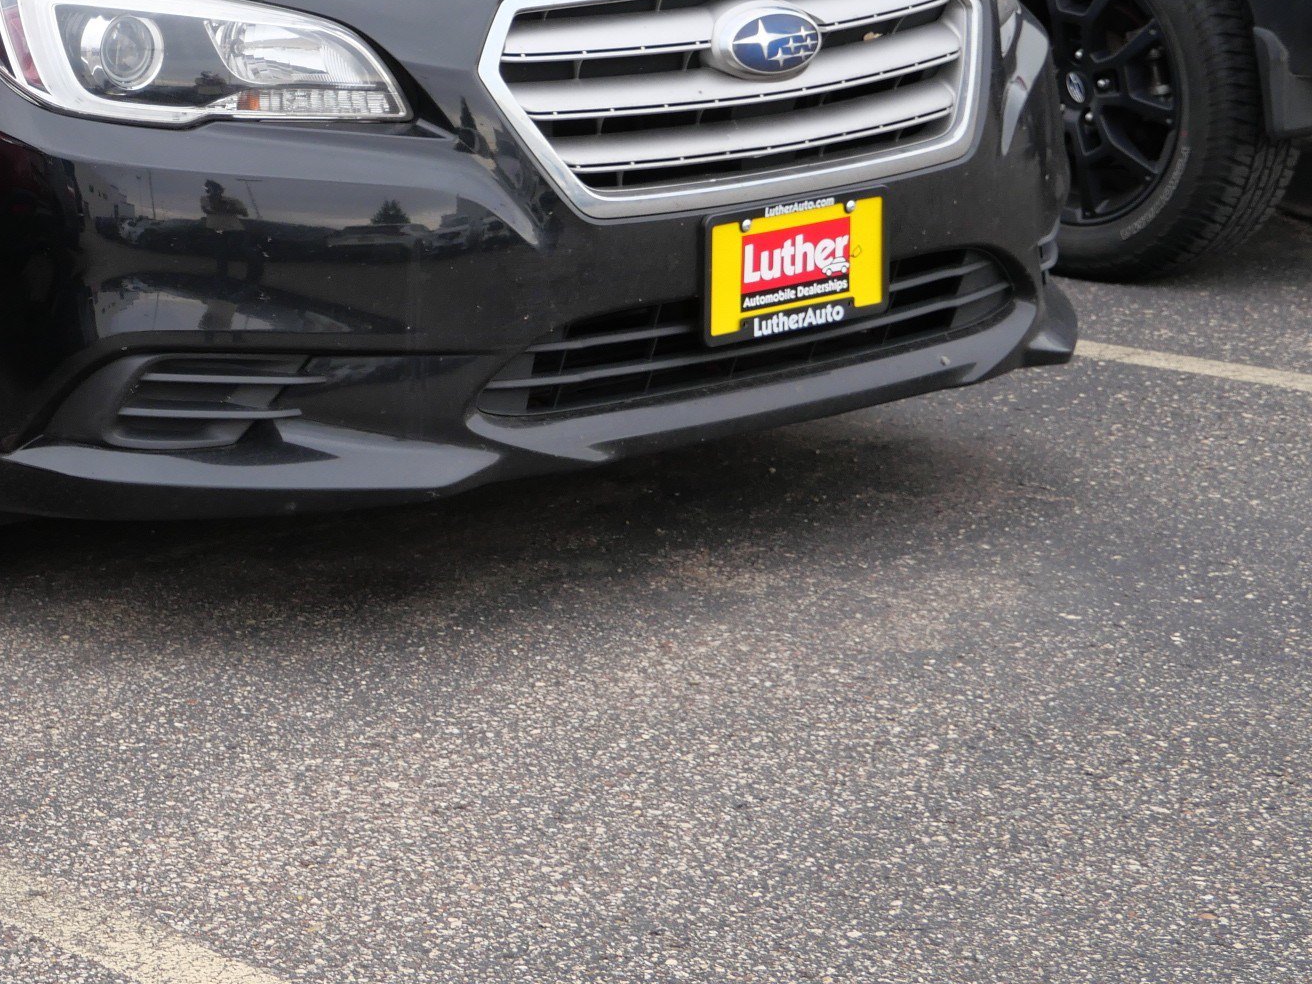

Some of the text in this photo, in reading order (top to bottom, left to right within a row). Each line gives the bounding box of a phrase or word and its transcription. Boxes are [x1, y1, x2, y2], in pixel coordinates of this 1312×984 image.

[764, 197, 835, 218] LutherAuto.com
[743, 233, 850, 284] Luther
[742, 278, 849, 309] Automobile Dealerships
[753, 304, 845, 338] LutherAuto
